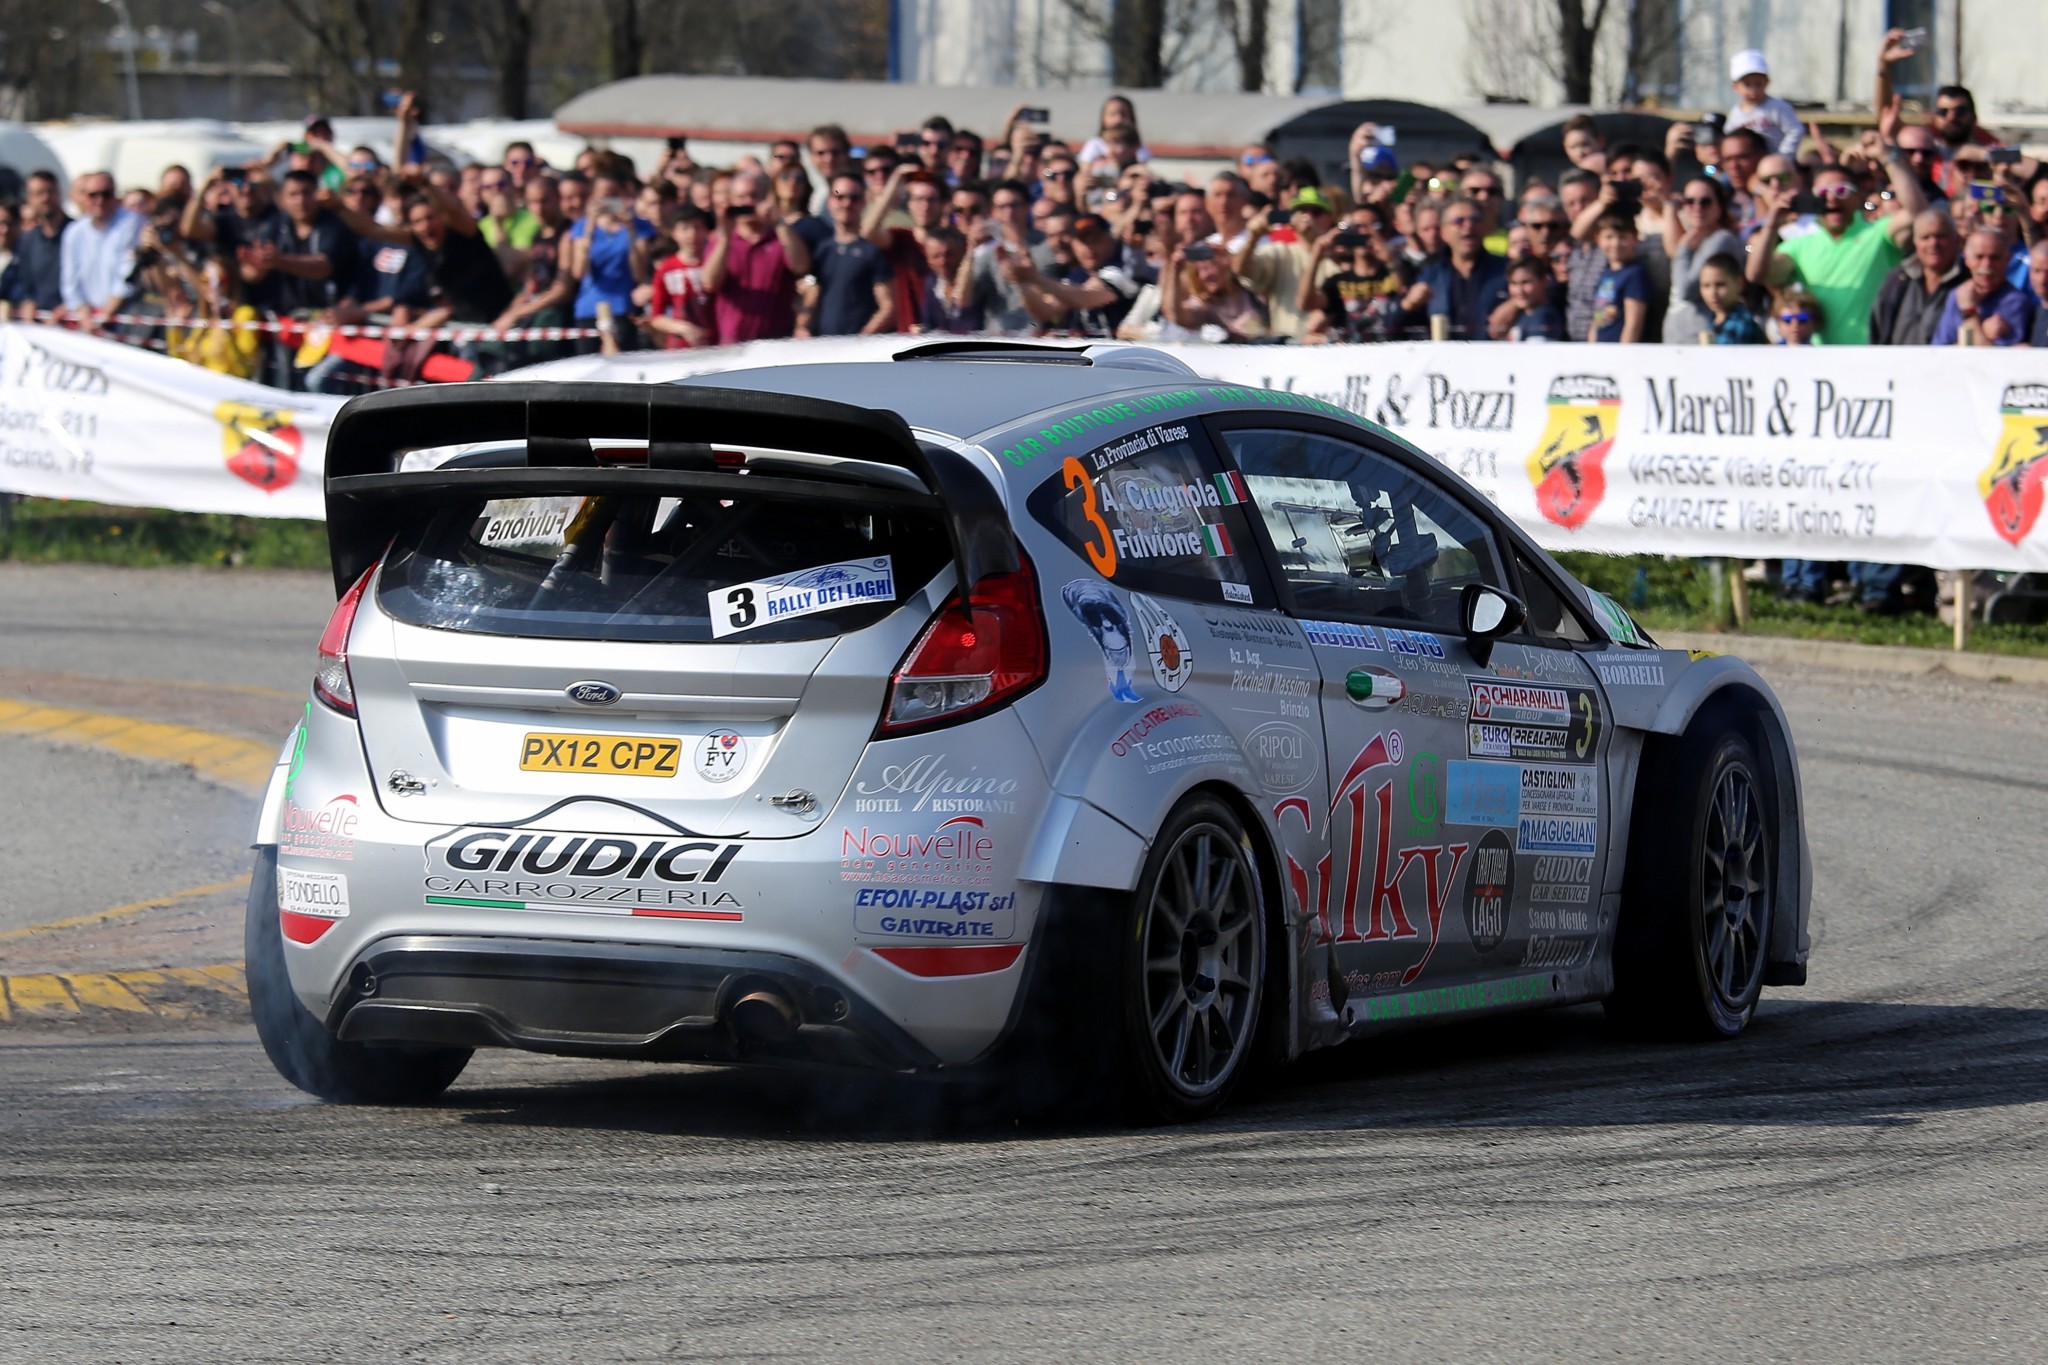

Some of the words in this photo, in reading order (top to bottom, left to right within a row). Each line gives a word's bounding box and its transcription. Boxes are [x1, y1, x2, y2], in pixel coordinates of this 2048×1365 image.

[1425, 374, 1516, 432] Pozzi
[1642, 376, 1754, 436] Marelli
[1766, 377, 1797, 437] &
[1812, 378, 1896, 440] Pozzi
[1003, 437, 1047, 467] CAR
[1039, 402, 1137, 446] BOUTIQUE
[1130, 388, 1204, 414] LUXURY
[1091, 452, 1108, 471] La
[1103, 432, 1149, 466] Provincia
[1147, 430, 1159, 450] di
[1155, 424, 1190, 445] Varese
[1628, 453, 1720, 486] VARESE
[1724, 456, 1774, 488] Viale
[1101, 482, 1124, 512] A.
[1124, 477, 1222, 517] Crugnola
[1062, 455, 1118, 578] 3
[1628, 496, 1728, 529] GAVIRATE
[1737, 499, 1779, 533] Viale
[1854, 503, 1877, 536] 79
[1112, 528, 1203, 560] Fulvione
[726, 587, 757, 628] 3
[767, 591, 813, 617] RALLY
[817, 586, 842, 606] DEI
[846, 578, 893, 600] LAGHI
[1229, 647, 1244, 664] Az.
[1381, 626, 1446, 659] AUTO
[1418, 656, 1462, 679] Parquet
[1599, 665, 1665, 687] BORRELLI
[576, 684, 608, 702] Ford
[1231, 669, 1274, 694] Piccinelli
[1271, 672, 1311, 698] Massimo
[1279, 699, 1310, 719] Brinzio
[1491, 686, 1566, 710] CHIARAVALLI
[1515, 709, 1543, 720] GROUP
[1574, 691, 1594, 759] 3
[1259, 735, 1302, 759] RIPOLI
[1481, 725, 1510, 744] EURO
[1513, 728, 1567, 747] PREALPINA
[522, 738, 599, 768] PX12
[610, 743, 679, 772] CPZ
[856, 753, 1021, 813] Alpino
[1264, 773, 1296, 785] VARESE
[1521, 768, 1576, 790] CASTIGLIONI
[855, 798, 903, 813] HOTEL
[931, 798, 1017, 815] RISTORANTE
[1522, 800, 1531, 810] PER
[1531, 801, 1547, 811] VARESE
[840, 825, 994, 862] Nouvelle
[1530, 819, 1597, 844] MAGUGLIANI
[445, 831, 745, 884] GIUDICI
[840, 858, 876, 870] new
[887, 860, 993, 874] generation
[1533, 856, 1594, 884] GIUDICI
[424, 875, 744, 908] CARROZZERIA
[855, 888, 991, 916] EFON-PLAST
[988, 890, 1016, 912] srl
[1531, 885, 1550, 901] CAR
[1551, 886, 1589, 902] SERVICE
[880, 916, 994, 937] GAVIRATE
[1472, 896, 1502, 937] LAGO
[1528, 908, 1556, 931] Sacro
[1557, 909, 1589, 932] Monte
[1368, 993, 1401, 1022] CAR
[1408, 981, 1487, 1017] BOUTIQUE
[1489, 975, 1549, 1008] LUXURY
